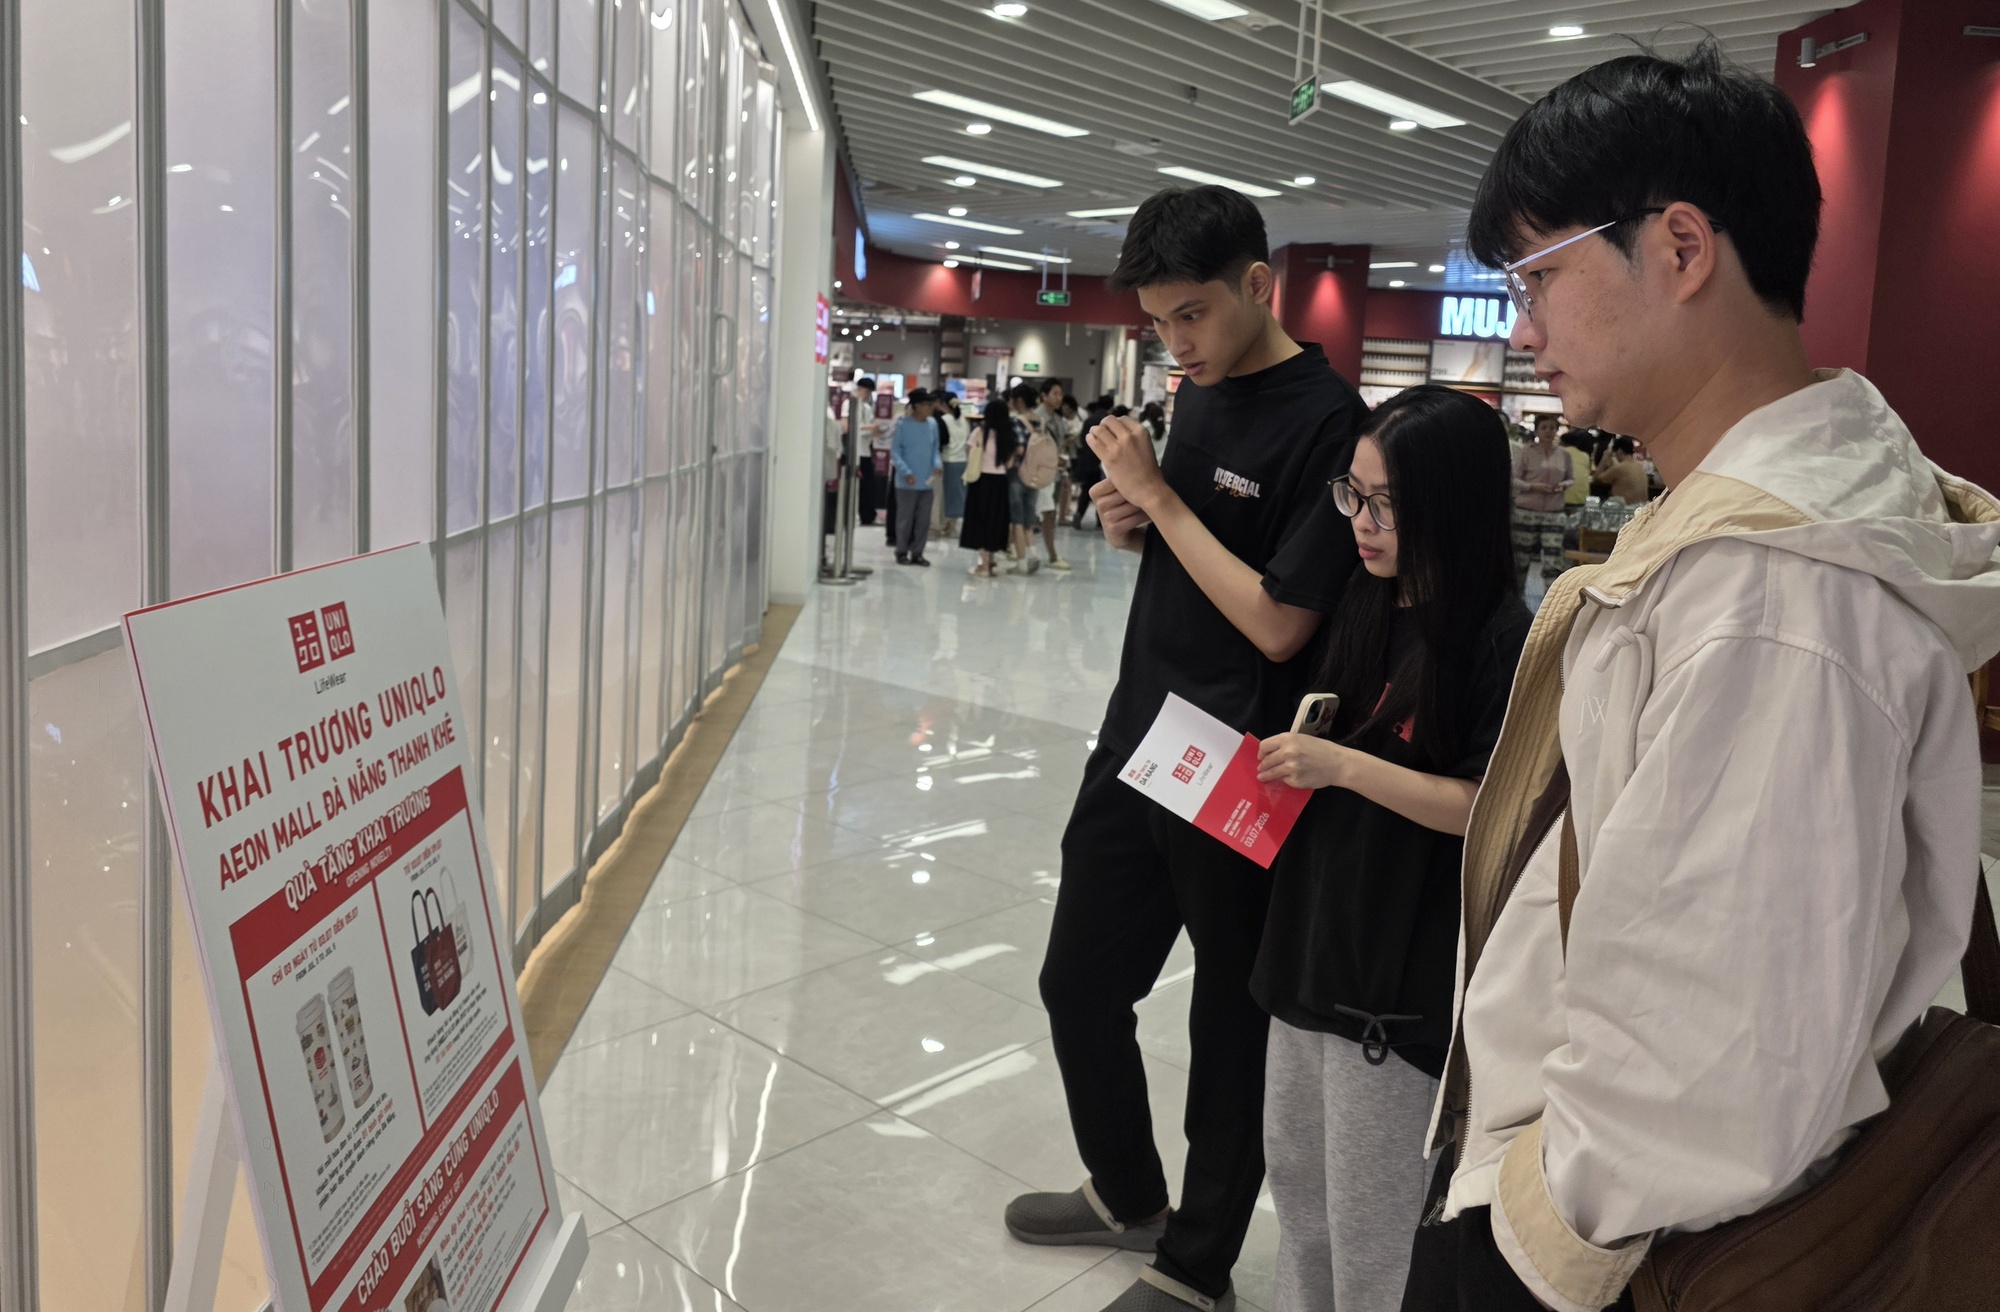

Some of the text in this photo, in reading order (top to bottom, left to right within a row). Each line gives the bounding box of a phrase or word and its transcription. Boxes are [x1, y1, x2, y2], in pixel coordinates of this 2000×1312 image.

[1440, 296, 1518, 339] MUJ
[314, 672, 347, 694] LifeWear
[197, 666, 446, 829] KHAI TRƯƠNG UNIQLO
[219, 712, 455, 891] AEON MALL ĐÀ NẴNG THANH KHÊ
[318, 844, 355, 886] TẶNG
[356, 816, 387, 858] KHAI
[387, 786, 431, 834] TRƯƠNG
[1243, 812, 1270, 848] 03.07.2026
[346, 862, 370, 888] OPENING
[283, 961, 292, 976] 03
[358, 1249, 390, 1305] CHÀO
[389, 1198, 418, 1258] BUỔI
[416, 1178, 445, 1218] SÁNG
[444, 1140, 469, 1177] CÙNG
[469, 1089, 499, 1141] UNIQLO
[416, 1211, 439, 1249] MORNING
